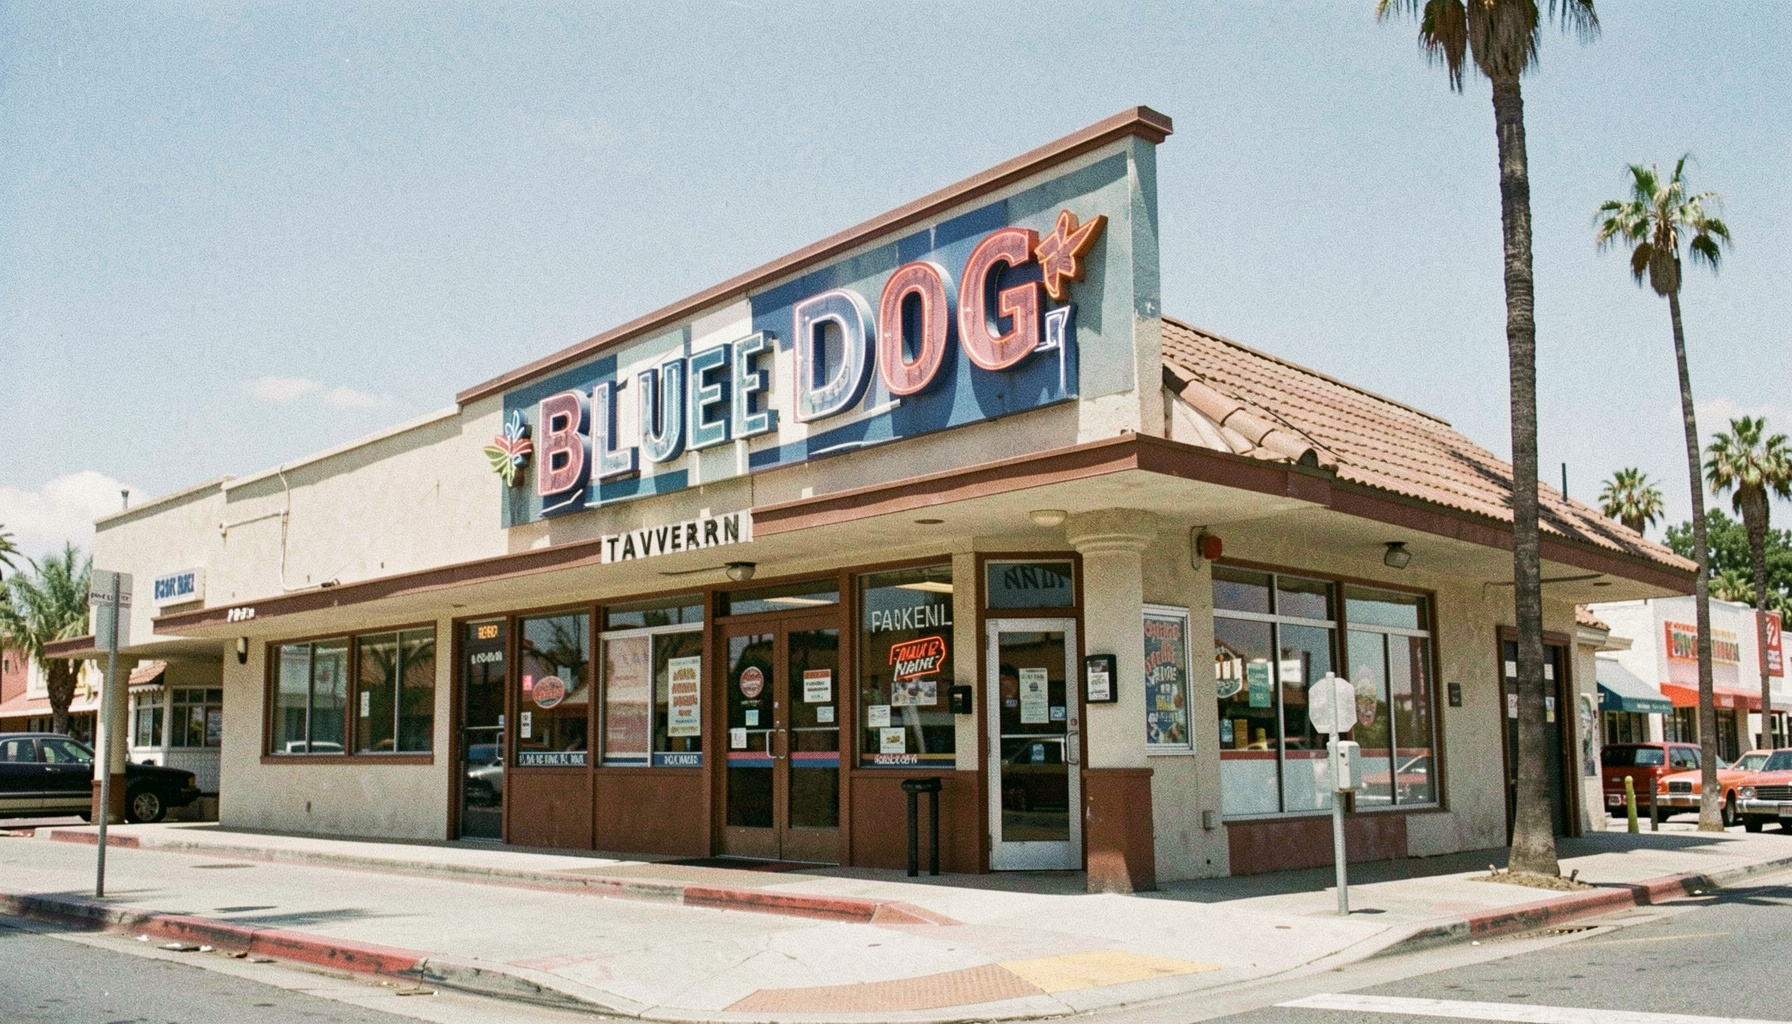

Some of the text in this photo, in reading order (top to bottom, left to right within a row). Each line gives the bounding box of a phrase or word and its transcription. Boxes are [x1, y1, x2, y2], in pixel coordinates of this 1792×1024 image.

[537, 226, 1041, 498] BLUEE DOG
[607, 513, 739, 562] TAVVERRN
